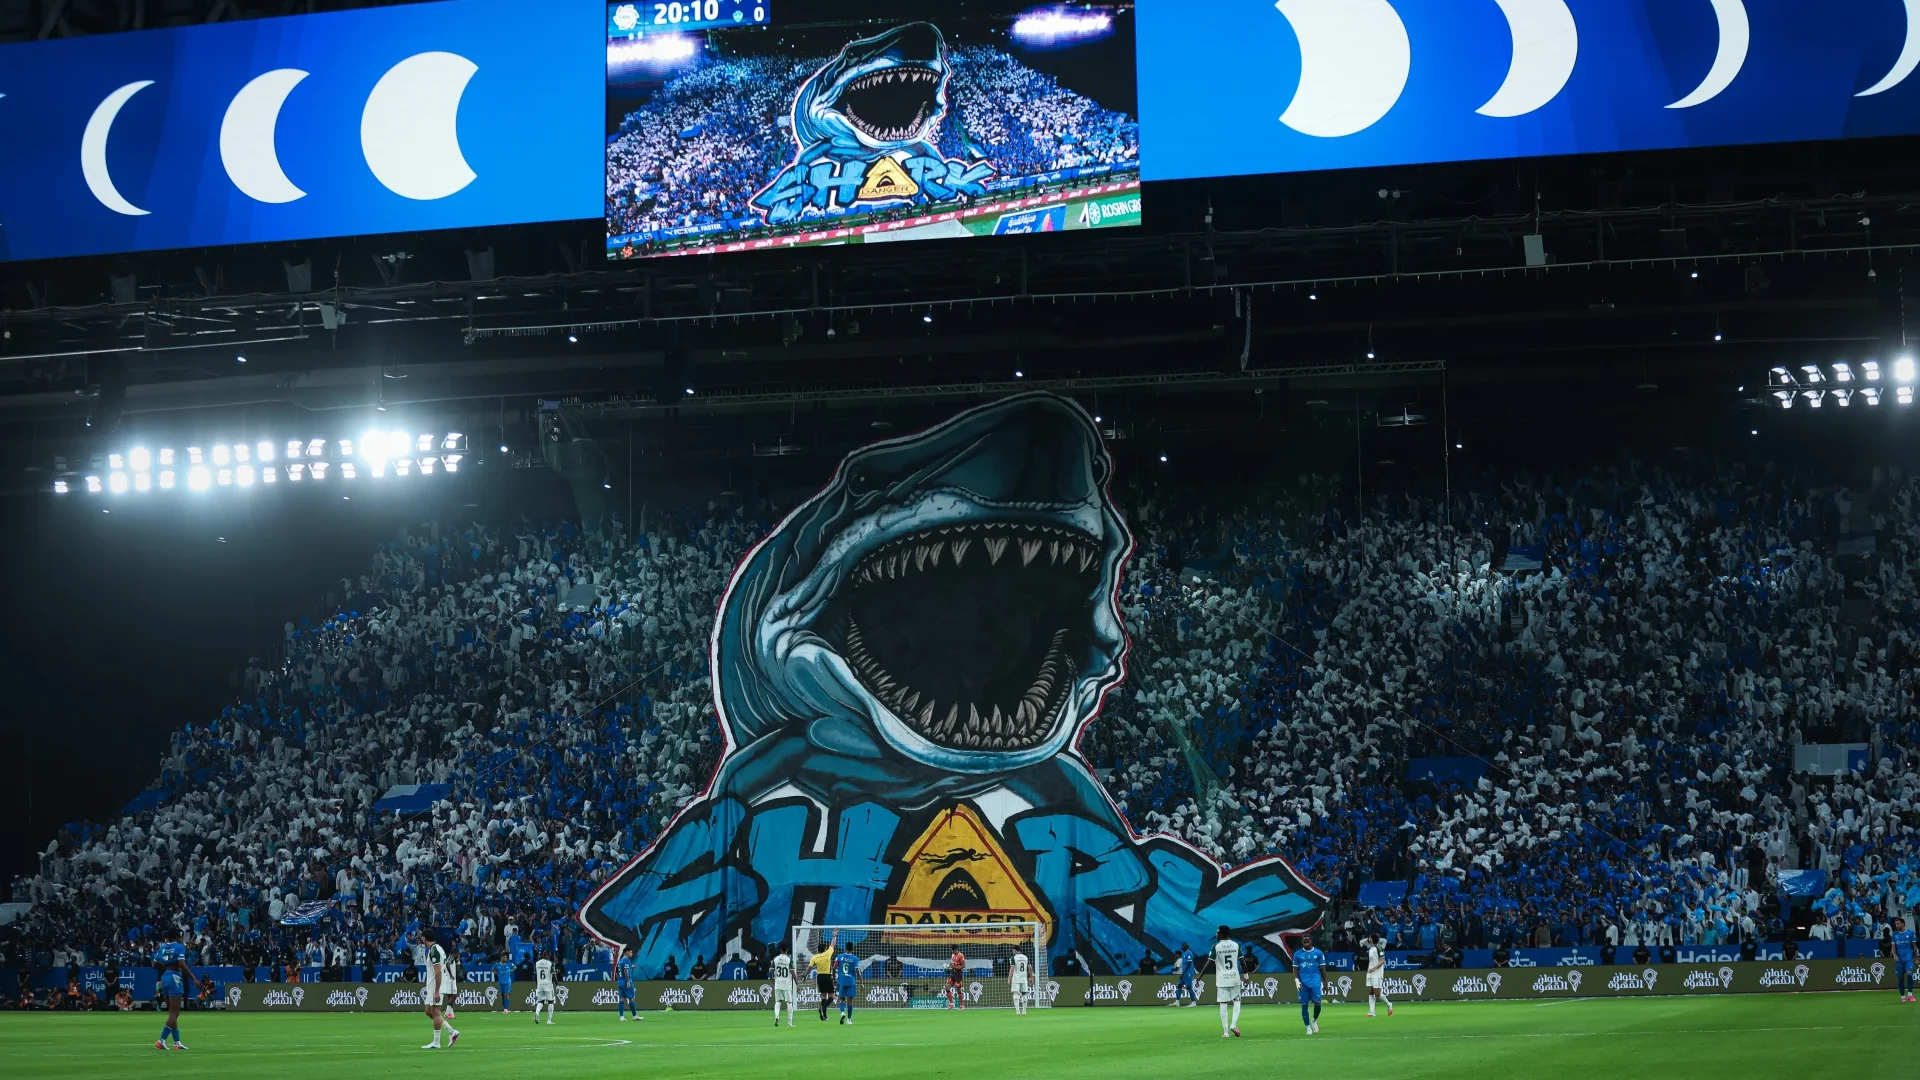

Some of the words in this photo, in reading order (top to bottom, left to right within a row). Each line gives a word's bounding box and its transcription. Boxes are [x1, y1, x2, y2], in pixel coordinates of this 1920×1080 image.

[654, 0, 719, 24] 20:10
[753, 7, 765, 22] 0
[861, 185, 909, 195] DANGER
[1101, 202, 1129, 218] ROSHN
[889, 912, 1026, 934] DANGER
[1019, 962, 1025, 973] 8
[1224, 954, 1233, 971] 5
[540, 969, 546, 980] 6
[776, 965, 789, 978] 30
[1688, 970, 1714, 981] عنوان
[1764, 968, 1790, 979] عنوان
[1840, 966, 1866, 977] عنوان
[1383, 978, 1407, 988] عنوان
[1457, 976, 1482, 987] عنوان
[1537, 974, 1563, 985] عنوان
[1613, 972, 1638, 983] عنوان
[1760, 976, 1795, 987] القهوة
[1836, 974, 1871, 985] القهوة
[85, 981, 106, 992] Riya
[119, 981, 134, 991] ank
[1452, 984, 1487, 994] القهوة
[1532, 982, 1568, 993] القهوة
[1608, 980, 1643, 991] القهوة
[1683, 978, 1719, 989] القهوة
[267, 989, 289, 999] عنوان
[330, 989, 352, 999] عنوان
[394, 989, 416, 999] عنوان
[459, 989, 482, 999] عنوان
[596, 988, 619, 998] عنوان
[663, 988, 687, 998] عنوان
[731, 987, 755, 997] عنوان
[870, 986, 894, 996] عنوان
[263, 996, 293, 1006] القهوة
[326, 996, 356, 1006] القهوة
[390, 996, 420, 1006] القهوة
[455, 996, 486, 1006] القهوة
[659, 995, 691, 1005] القهوة
[727, 994, 760, 1005] القهوة
[866, 993, 899, 1004] القهوة
